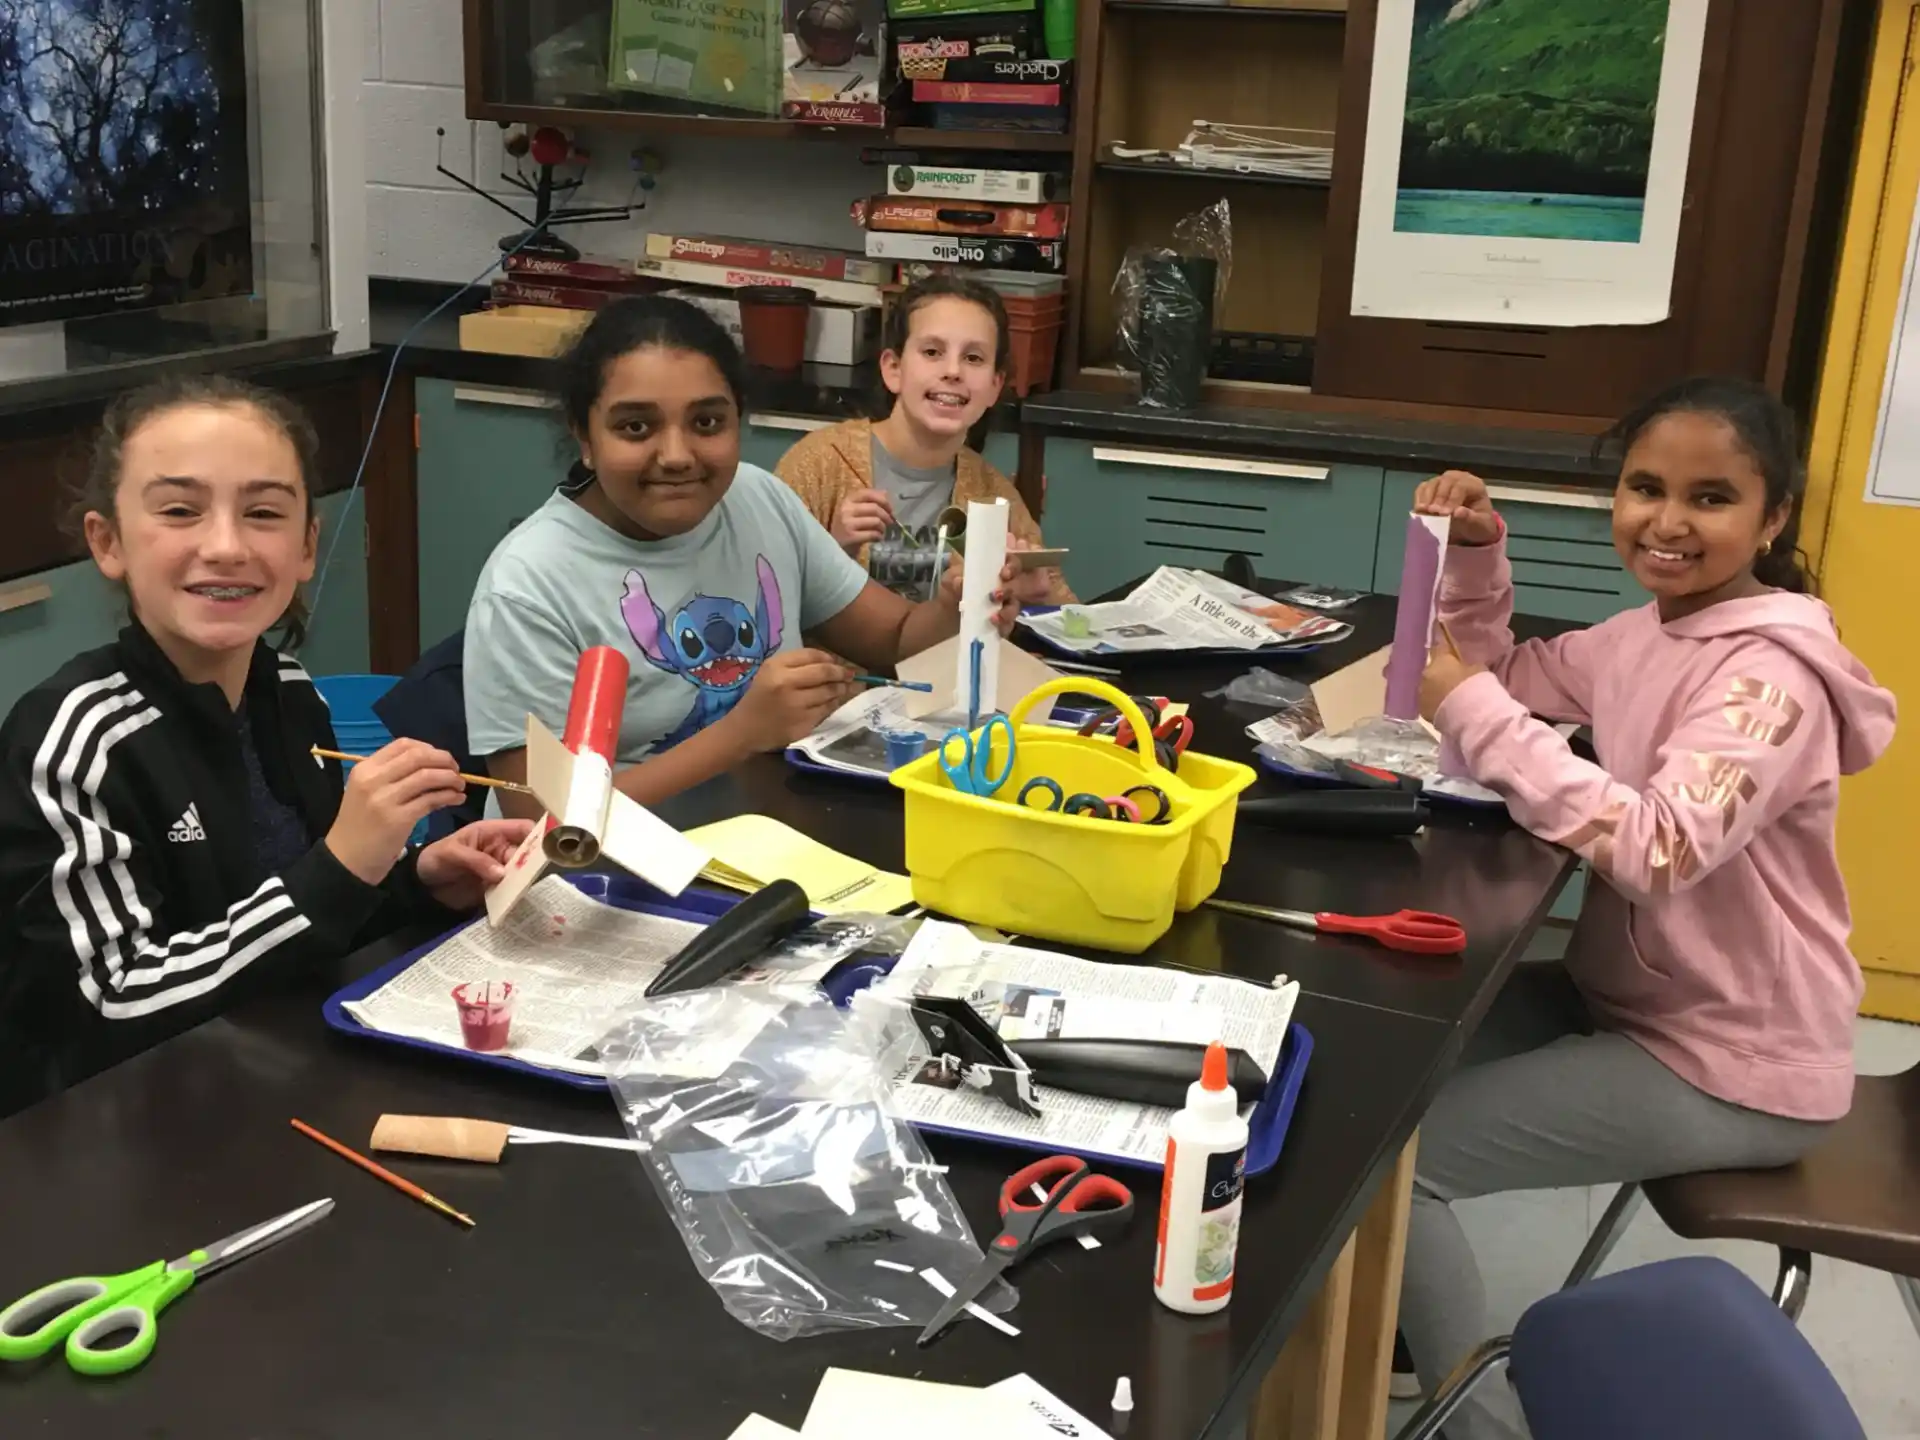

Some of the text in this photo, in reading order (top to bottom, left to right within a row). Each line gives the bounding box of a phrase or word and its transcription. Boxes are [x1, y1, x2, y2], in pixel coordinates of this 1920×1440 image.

[651, 9, 682, 25] Game
[685, 16, 696, 28] of
[994, 62, 1060, 80] Checkers
[805, 102, 864, 121] SCRABBLE
[915, 171, 977, 185] RAINFOREST
[884, 207, 933, 217] LASER
[673, 238, 726, 258] Stratego
[932, 244, 985, 261] Othello
[727, 271, 792, 287] MONOPOLY
[1188, 594, 1201, 607] A
[1200, 600, 1226, 620] title
[1224, 616, 1241, 631] on
[167, 826, 207, 843] adid
